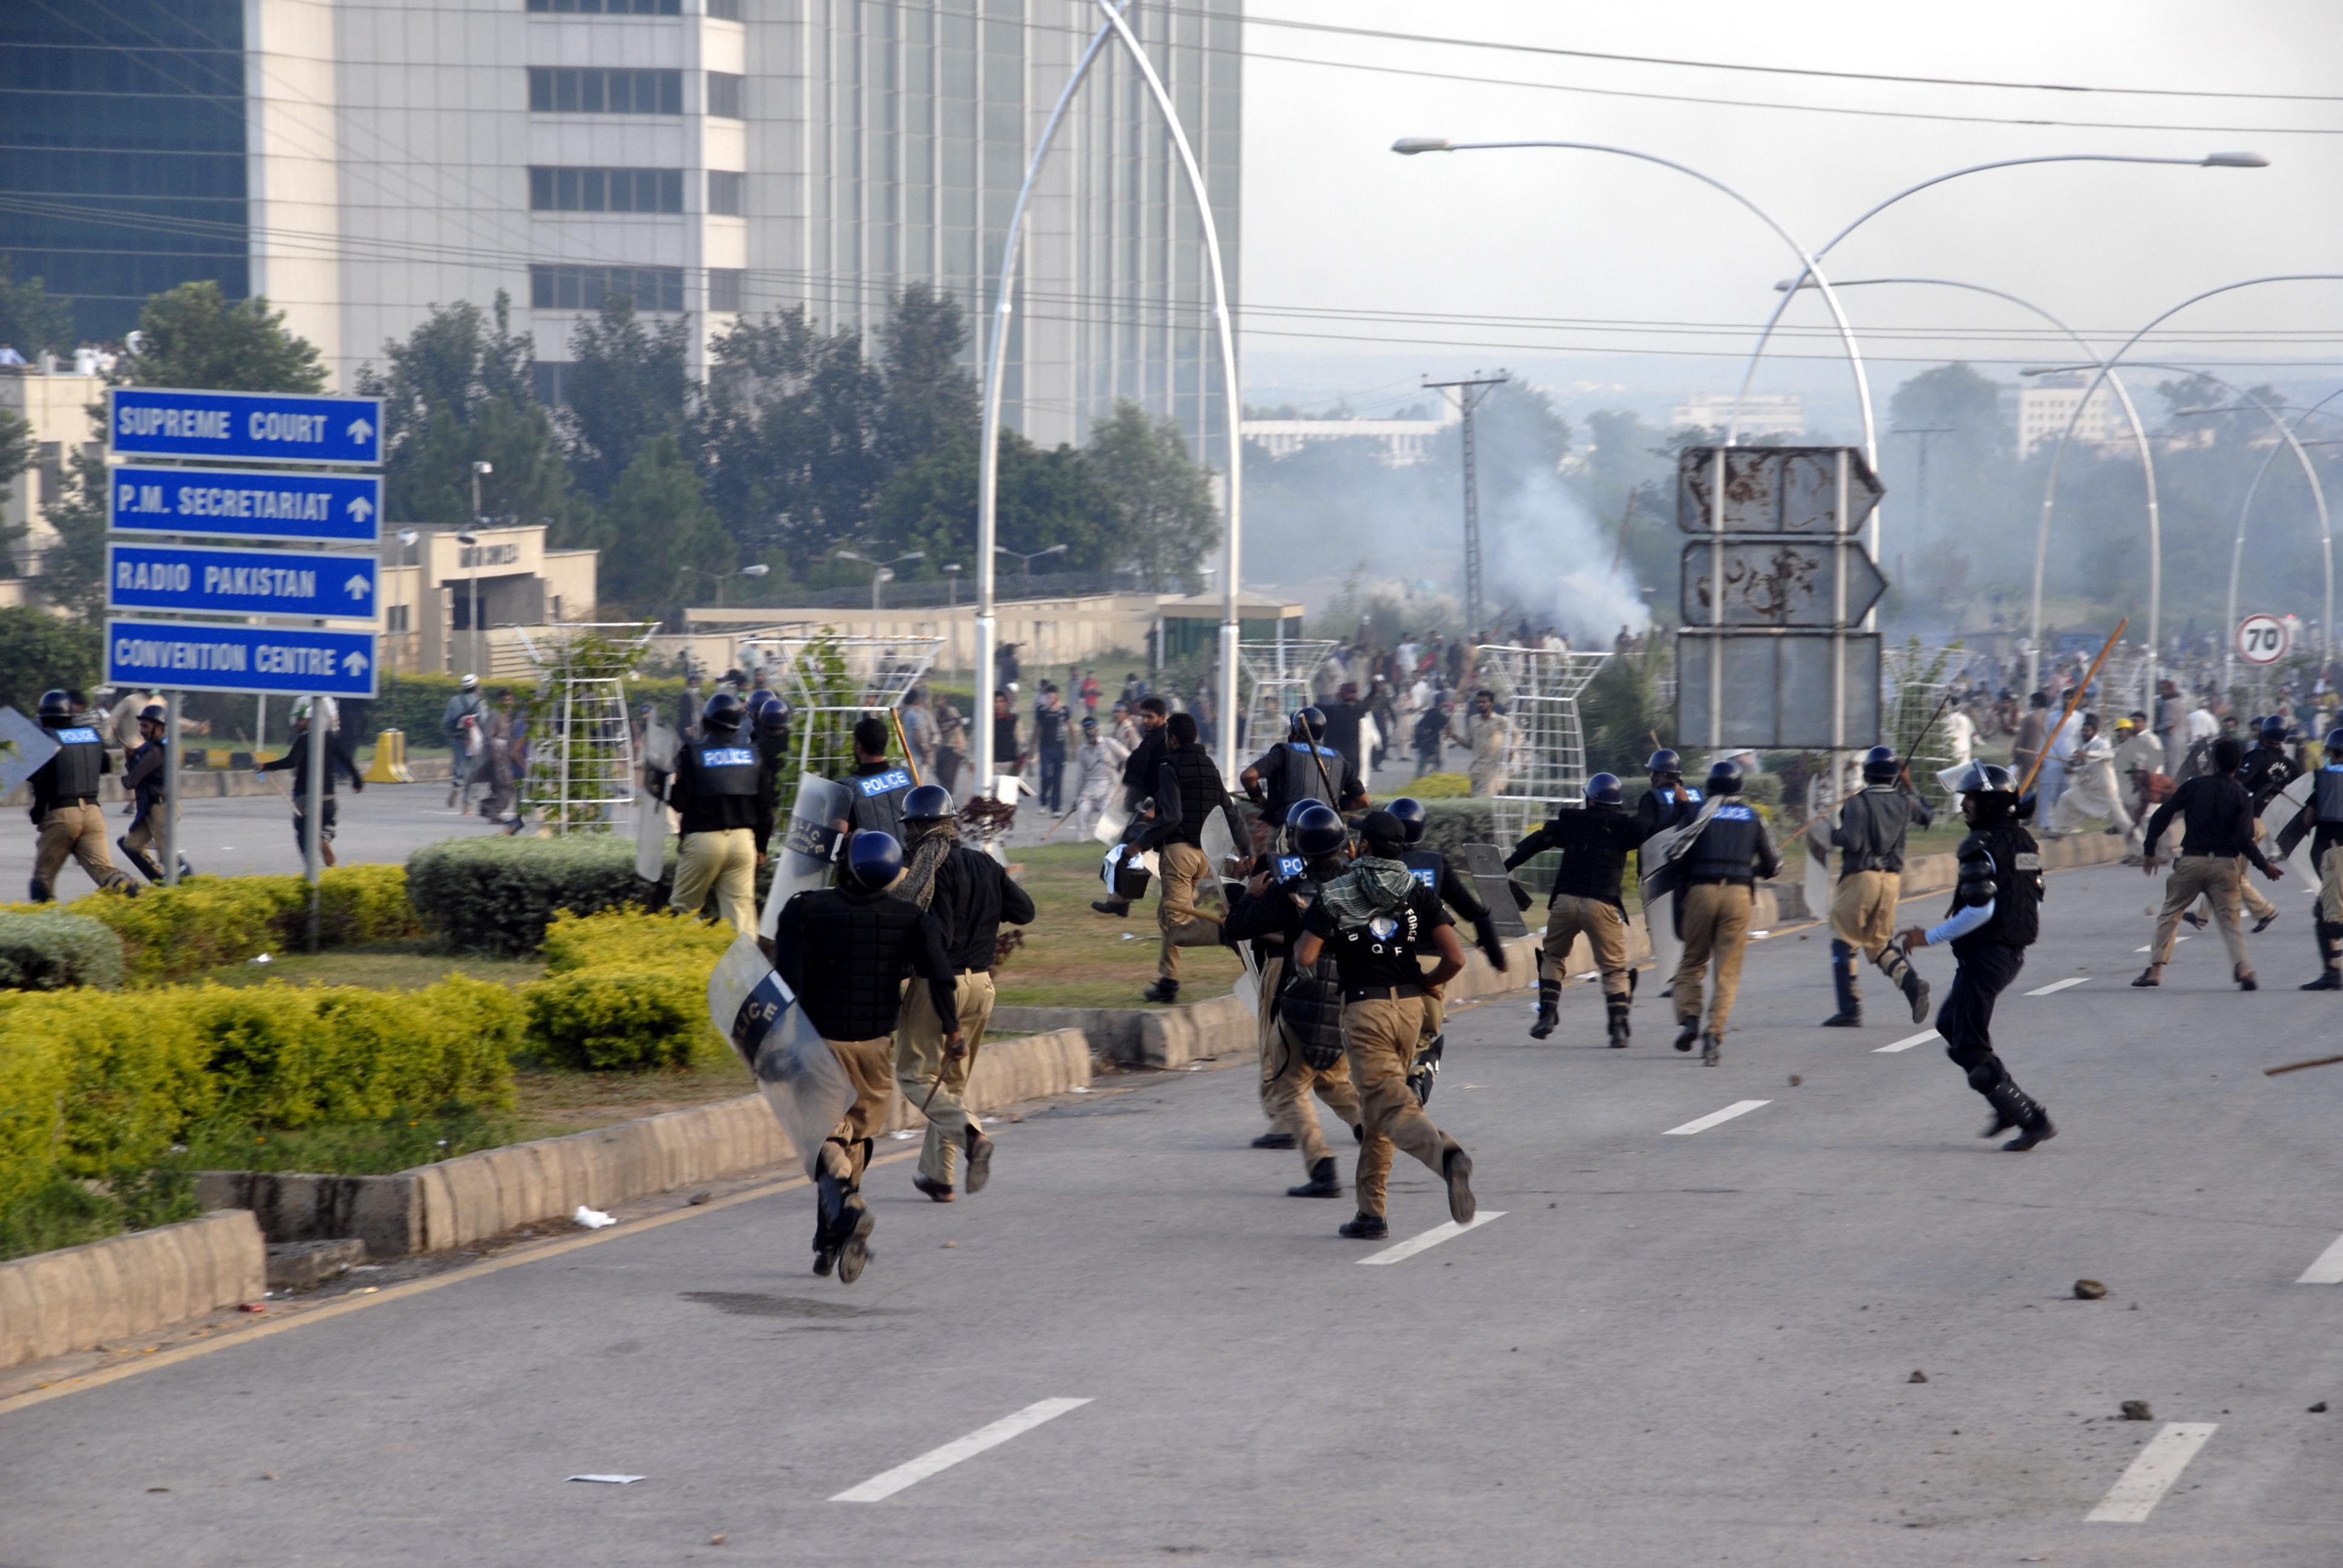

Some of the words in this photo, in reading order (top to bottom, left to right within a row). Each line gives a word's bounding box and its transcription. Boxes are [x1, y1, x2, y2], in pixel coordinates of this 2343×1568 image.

[119, 407, 232, 439] SUPREME
[249, 411, 327, 443] COURT
[118, 485, 171, 513] P.M.
[178, 486, 332, 520] SECRETARIAT
[117, 562, 191, 592] RADIO
[205, 566, 316, 598] PAKISTAN
[115, 638, 247, 671] CONVENTION
[255, 644, 336, 676] CENTRE
[2247, 628, 2277, 652] 70
[704, 750, 754, 765] POLICE
[861, 771, 907, 794] POLICE
[1404, 908, 1418, 942] FORCE
